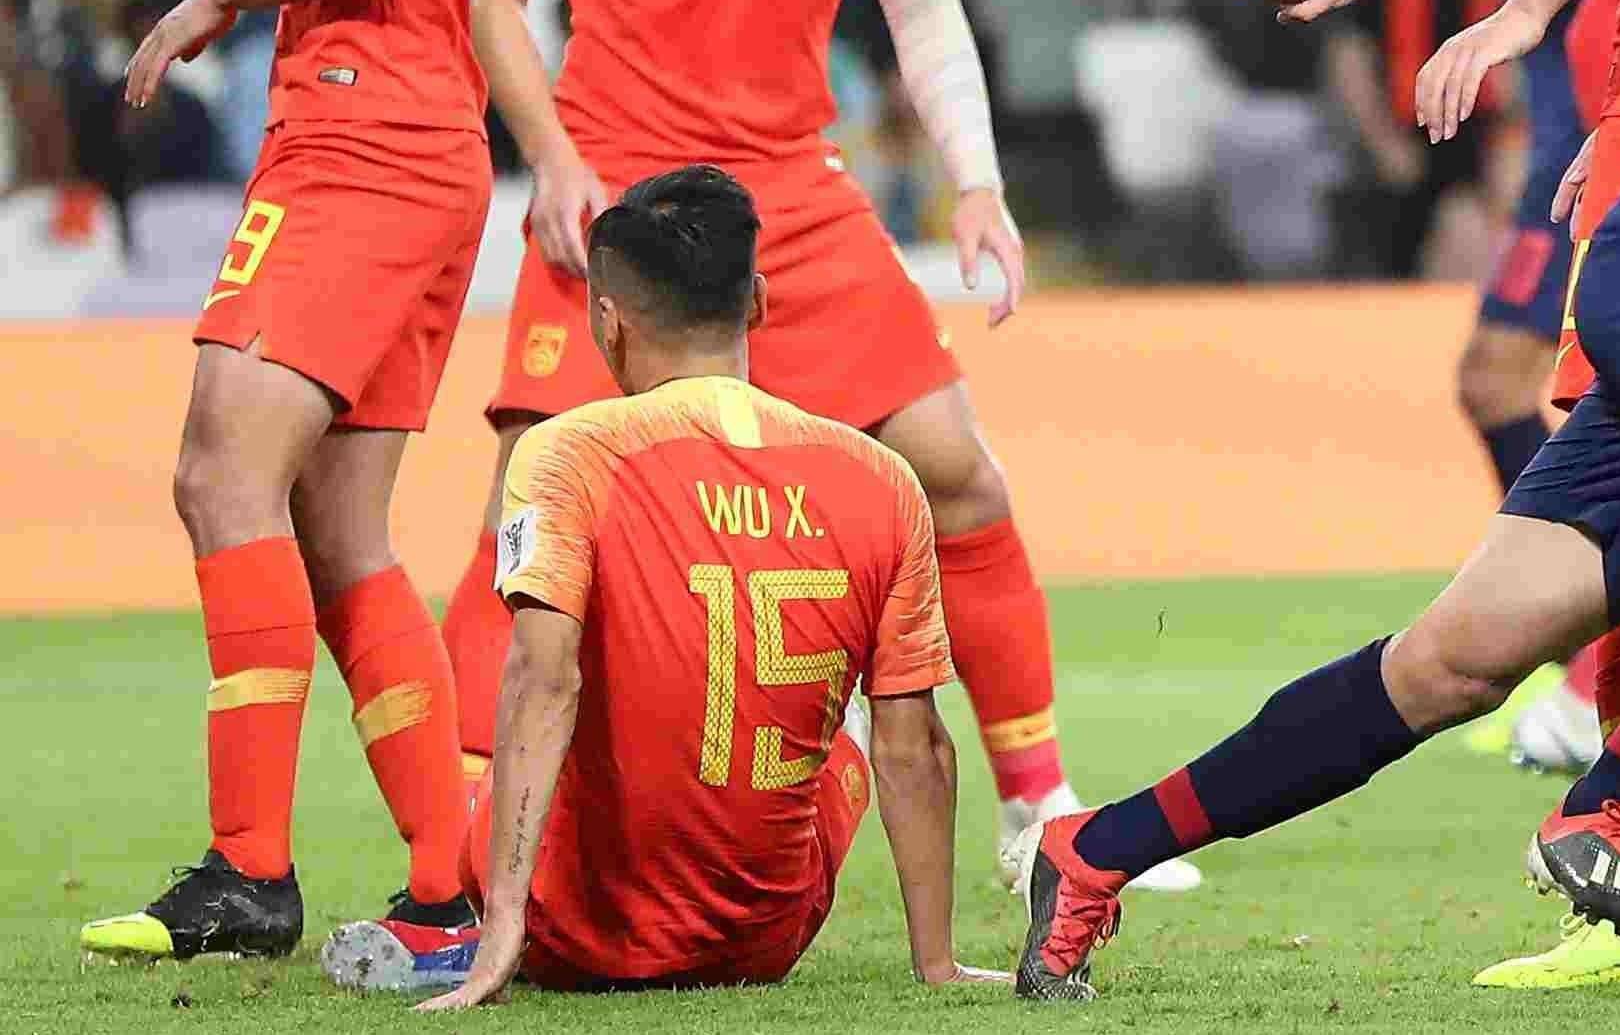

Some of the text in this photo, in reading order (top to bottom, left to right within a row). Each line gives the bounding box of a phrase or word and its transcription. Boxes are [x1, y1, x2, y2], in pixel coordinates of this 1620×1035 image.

[218, 199, 288, 286] 9
[696, 480, 771, 538] WU
[689, 564, 849, 791] 15
